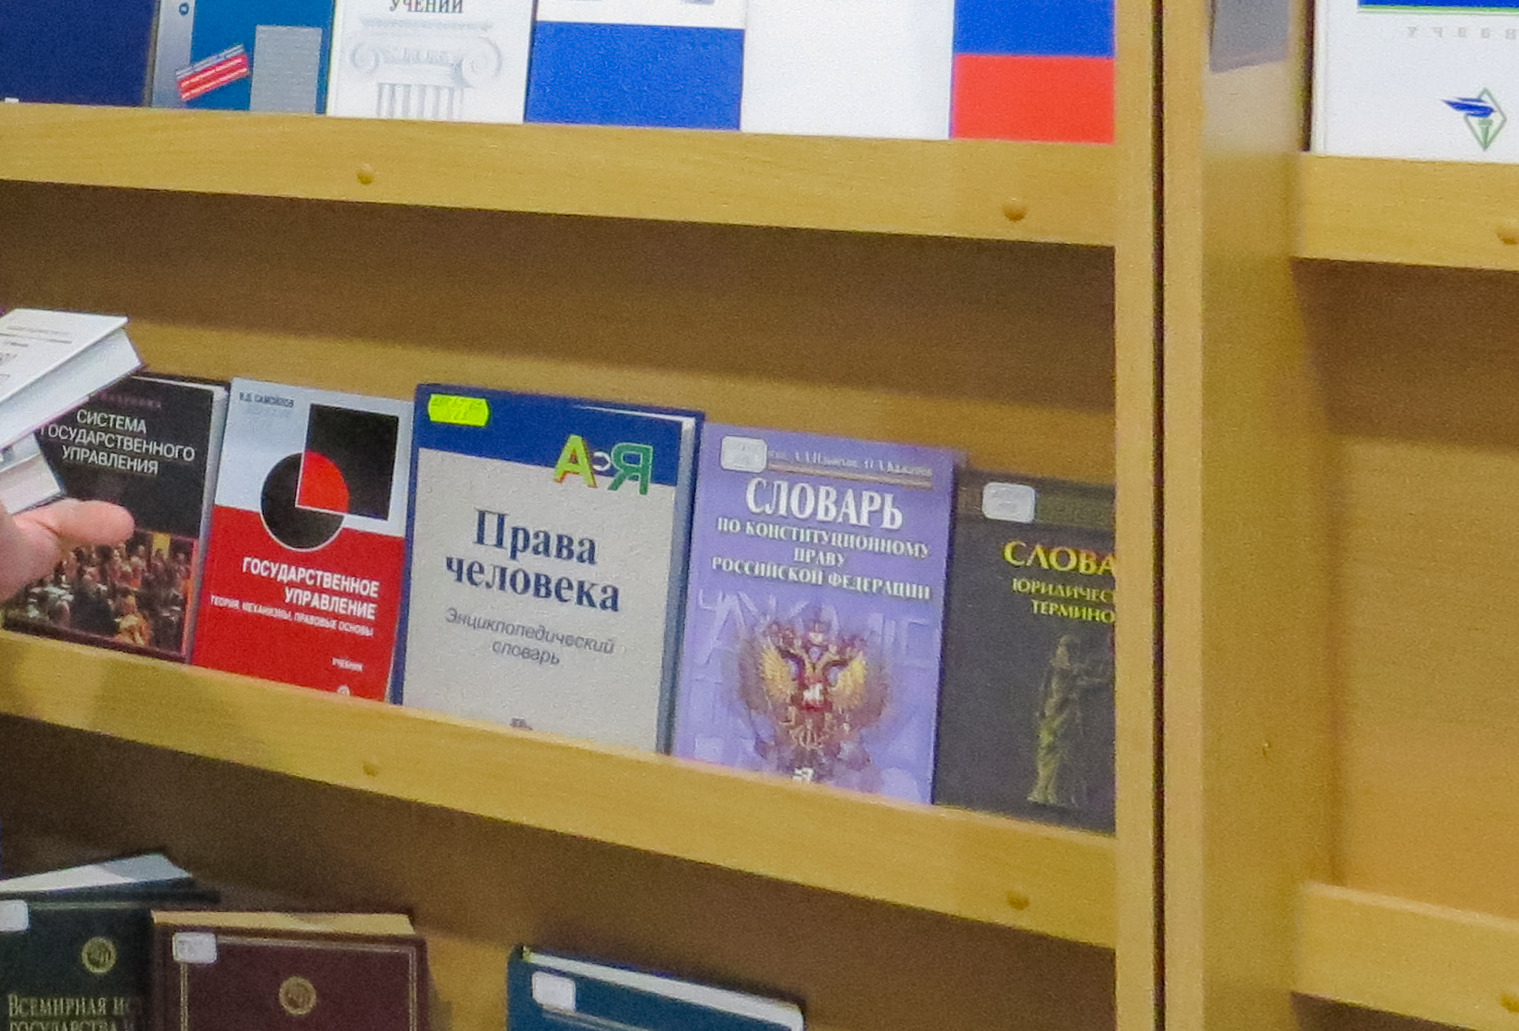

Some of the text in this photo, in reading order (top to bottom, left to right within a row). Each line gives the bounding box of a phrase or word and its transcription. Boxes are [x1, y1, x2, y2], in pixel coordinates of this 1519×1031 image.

[76, 409, 147, 434] СИСТЕМА
[62, 445, 159, 475] УПРАВЛЕНИЯ
[746, 476, 903, 530] СЛОВАРЬ
[473, 507, 598, 565] Права
[717, 516, 931, 559] ПО КОНСТИТУЦИОННОМУ
[793, 547, 847, 567] ПРАВУ
[1003, 539, 1115, 576] СЛОВА
[242, 556, 380, 599] ГОСУДАРСТВЕННОЕ
[445, 555, 620, 613] человека
[712, 556, 931, 600] РОССИЙСКОЙ ФЕДЕРАЦИИ
[284, 586, 376, 620] УПРАВЛЕНИЕ
[1031, 599, 1115, 624] ТЕРМИНО
[445, 607, 616, 655] Энциклопедический
[491, 640, 560, 666] словарь
